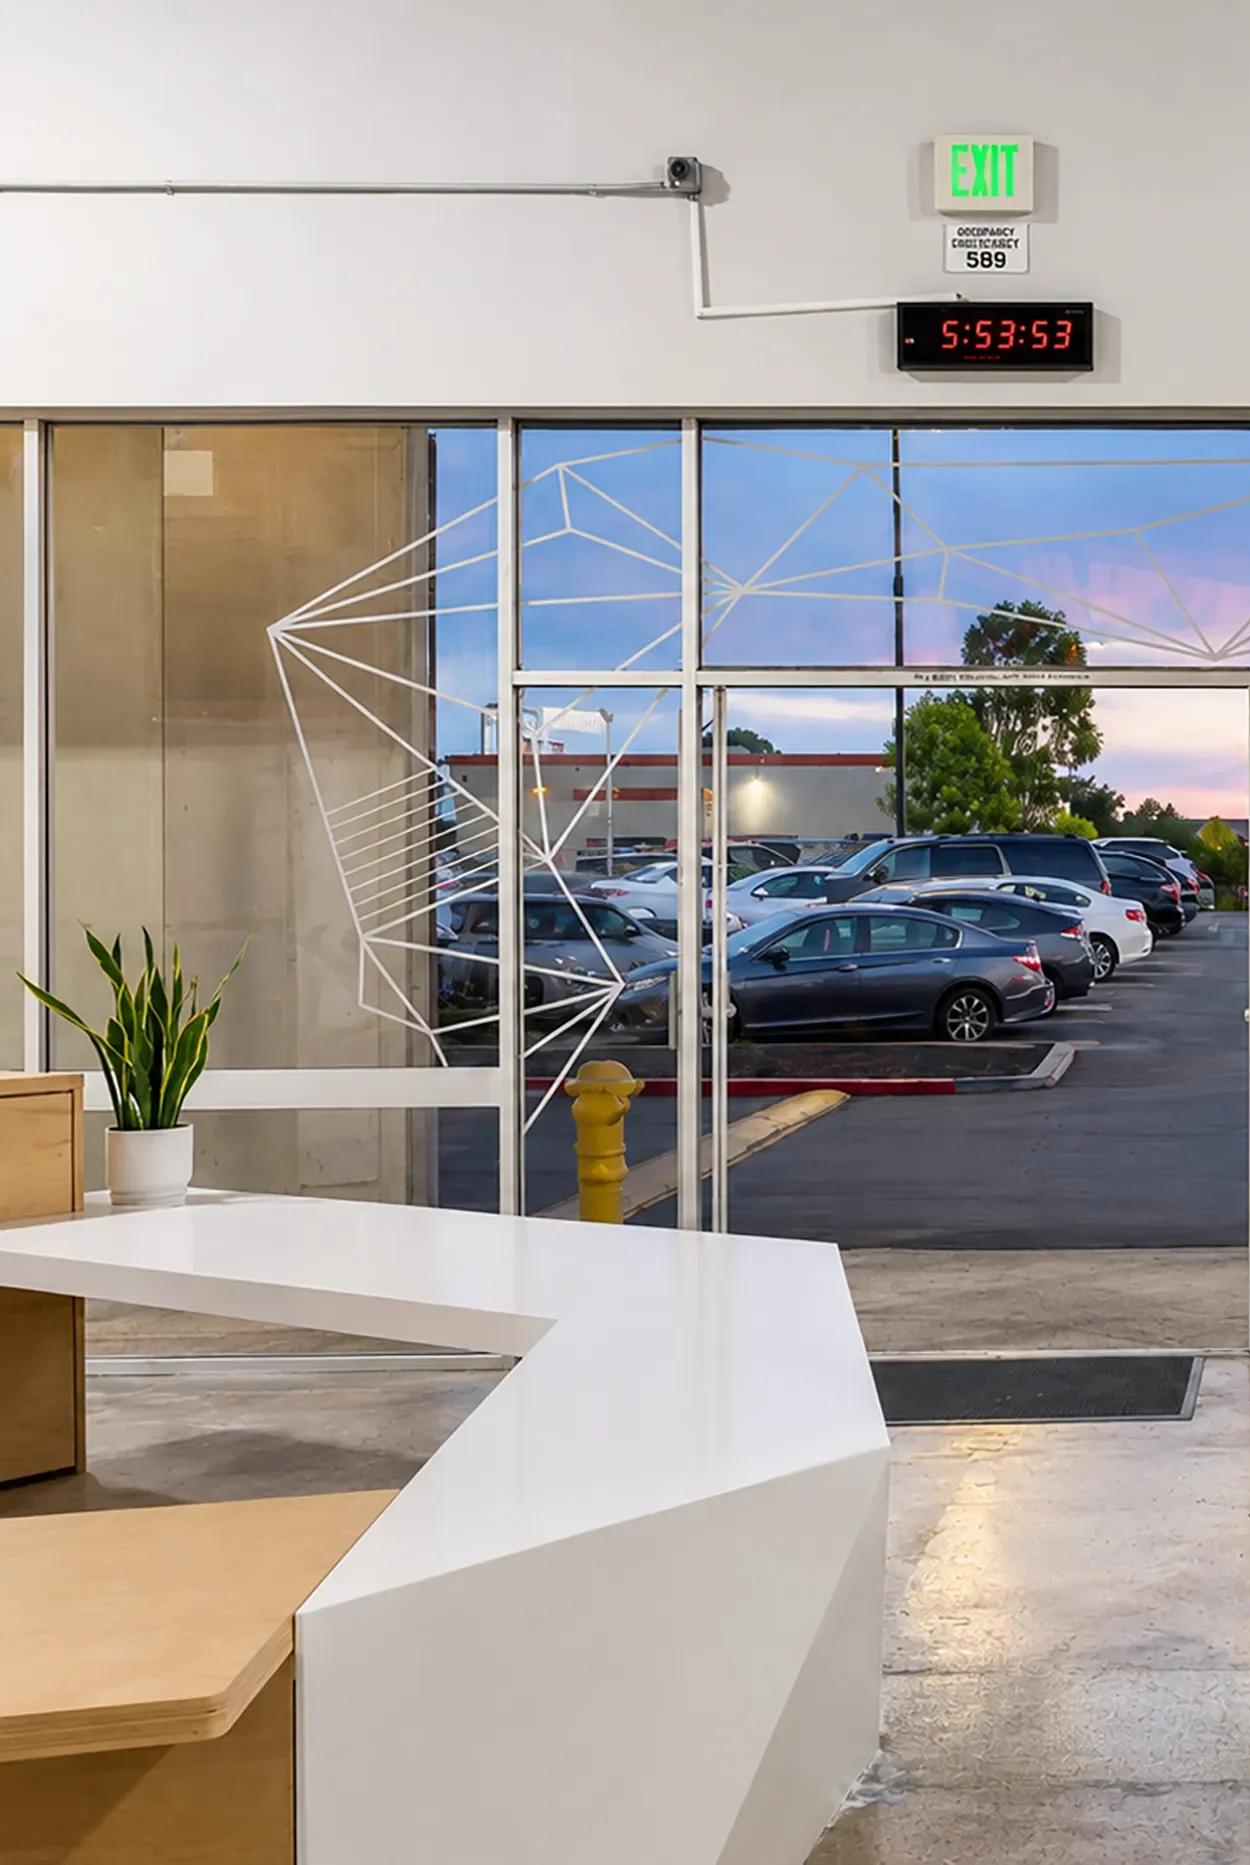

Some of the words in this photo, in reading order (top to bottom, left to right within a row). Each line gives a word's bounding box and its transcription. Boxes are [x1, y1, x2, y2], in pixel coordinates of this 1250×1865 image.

[951, 143, 1018, 197] EXIT
[966, 251, 1006, 269] 589
[941, 320, 1073, 349] 5:53:53
